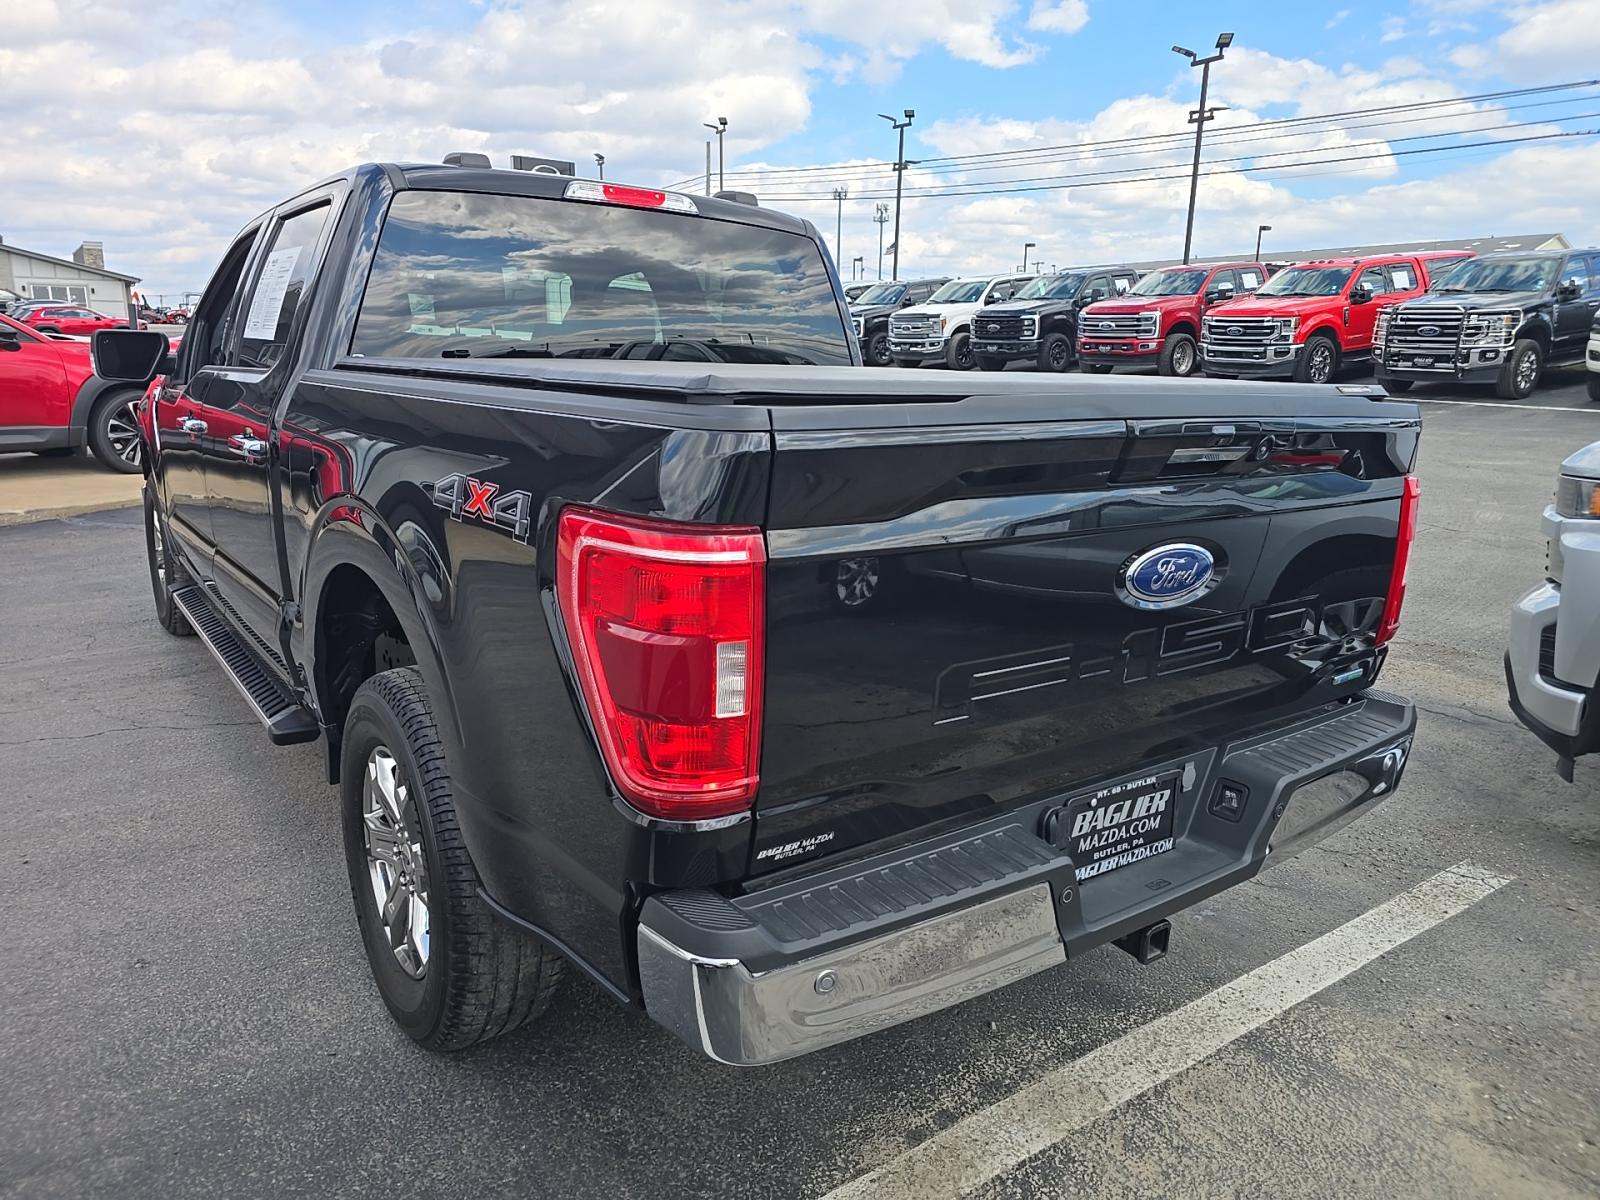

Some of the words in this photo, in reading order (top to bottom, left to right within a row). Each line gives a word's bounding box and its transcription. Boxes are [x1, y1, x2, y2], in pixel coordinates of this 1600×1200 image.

[1150, 556, 1199, 591] Ford
[931, 593, 1321, 726] F-150
[1127, 776, 1157, 790] BUTLER
[1071, 788, 1171, 838] BAGLIER
[756, 841, 801, 860] BAGLIER
[801, 830, 835, 848] MAZDA
[1077, 814, 1162, 854] MAZDA.COM
[1132, 837, 1144, 848] PA
